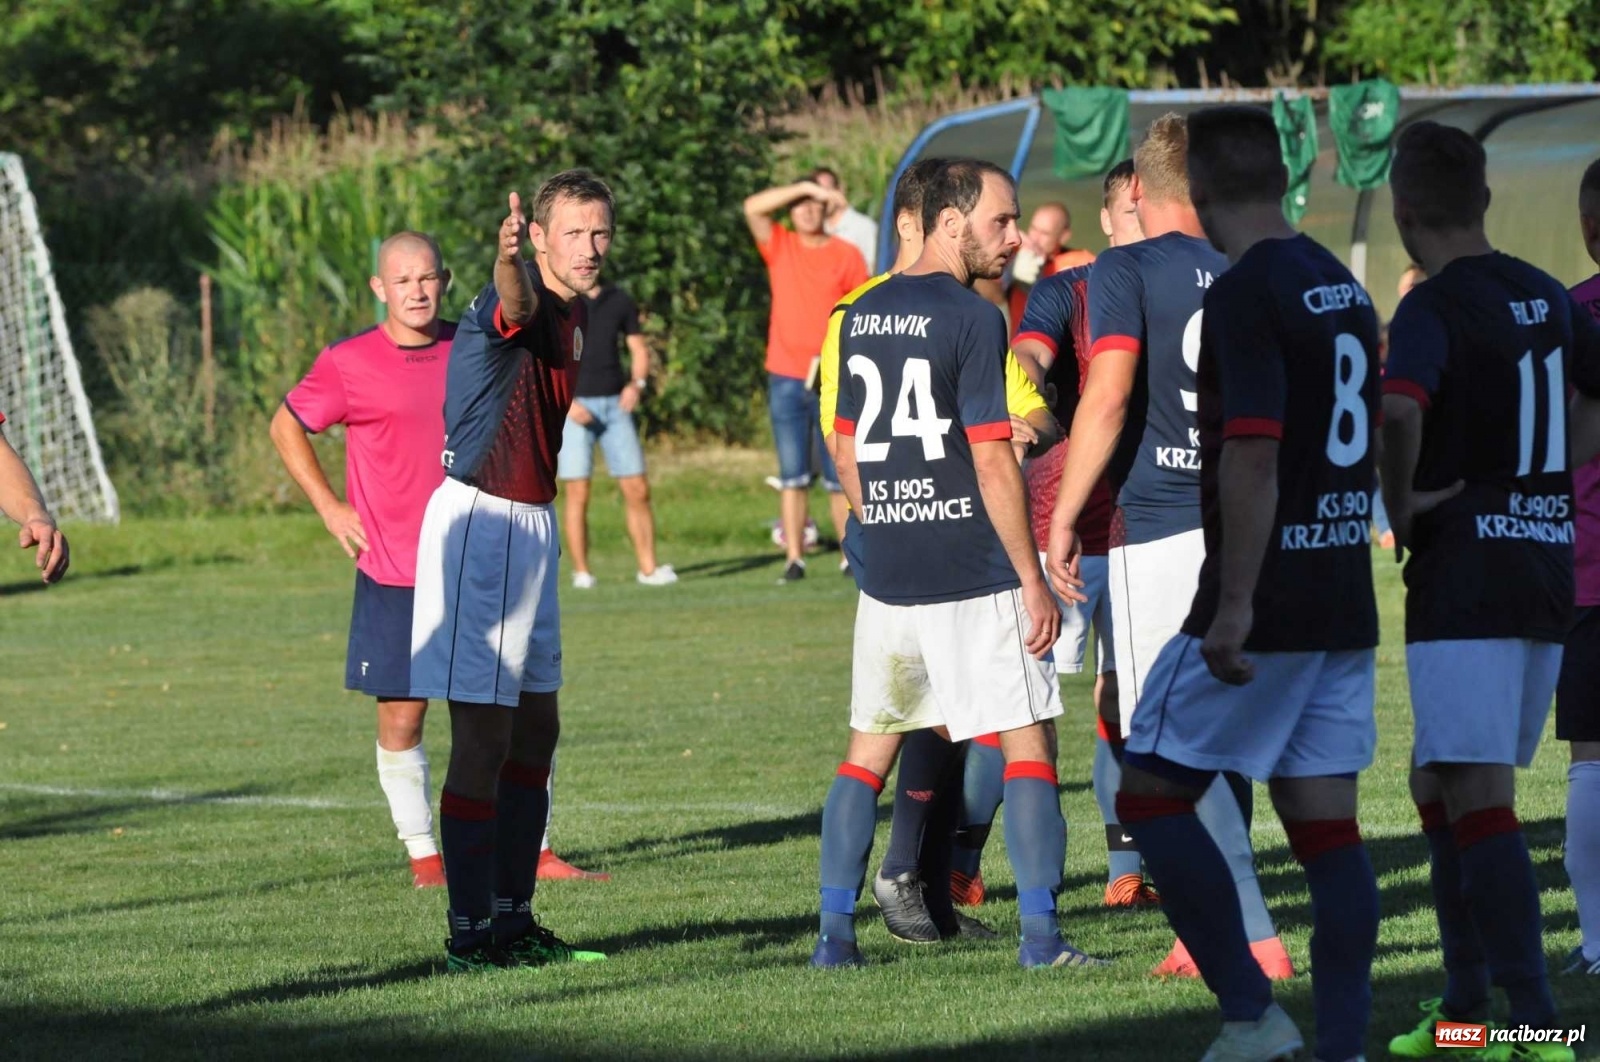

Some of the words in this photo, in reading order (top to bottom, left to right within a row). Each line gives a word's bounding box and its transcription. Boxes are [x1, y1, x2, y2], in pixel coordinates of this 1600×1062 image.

[1195, 267, 1221, 289] JA
[850, 313, 932, 338] ŻURAWIK
[846, 353, 953, 463] 24
[1325, 332, 1369, 468] 8
[1516, 345, 1567, 477] 11
[868, 480, 889, 502] KS
[893, 478, 935, 502] 1905
[1317, 493, 1341, 518] KS
